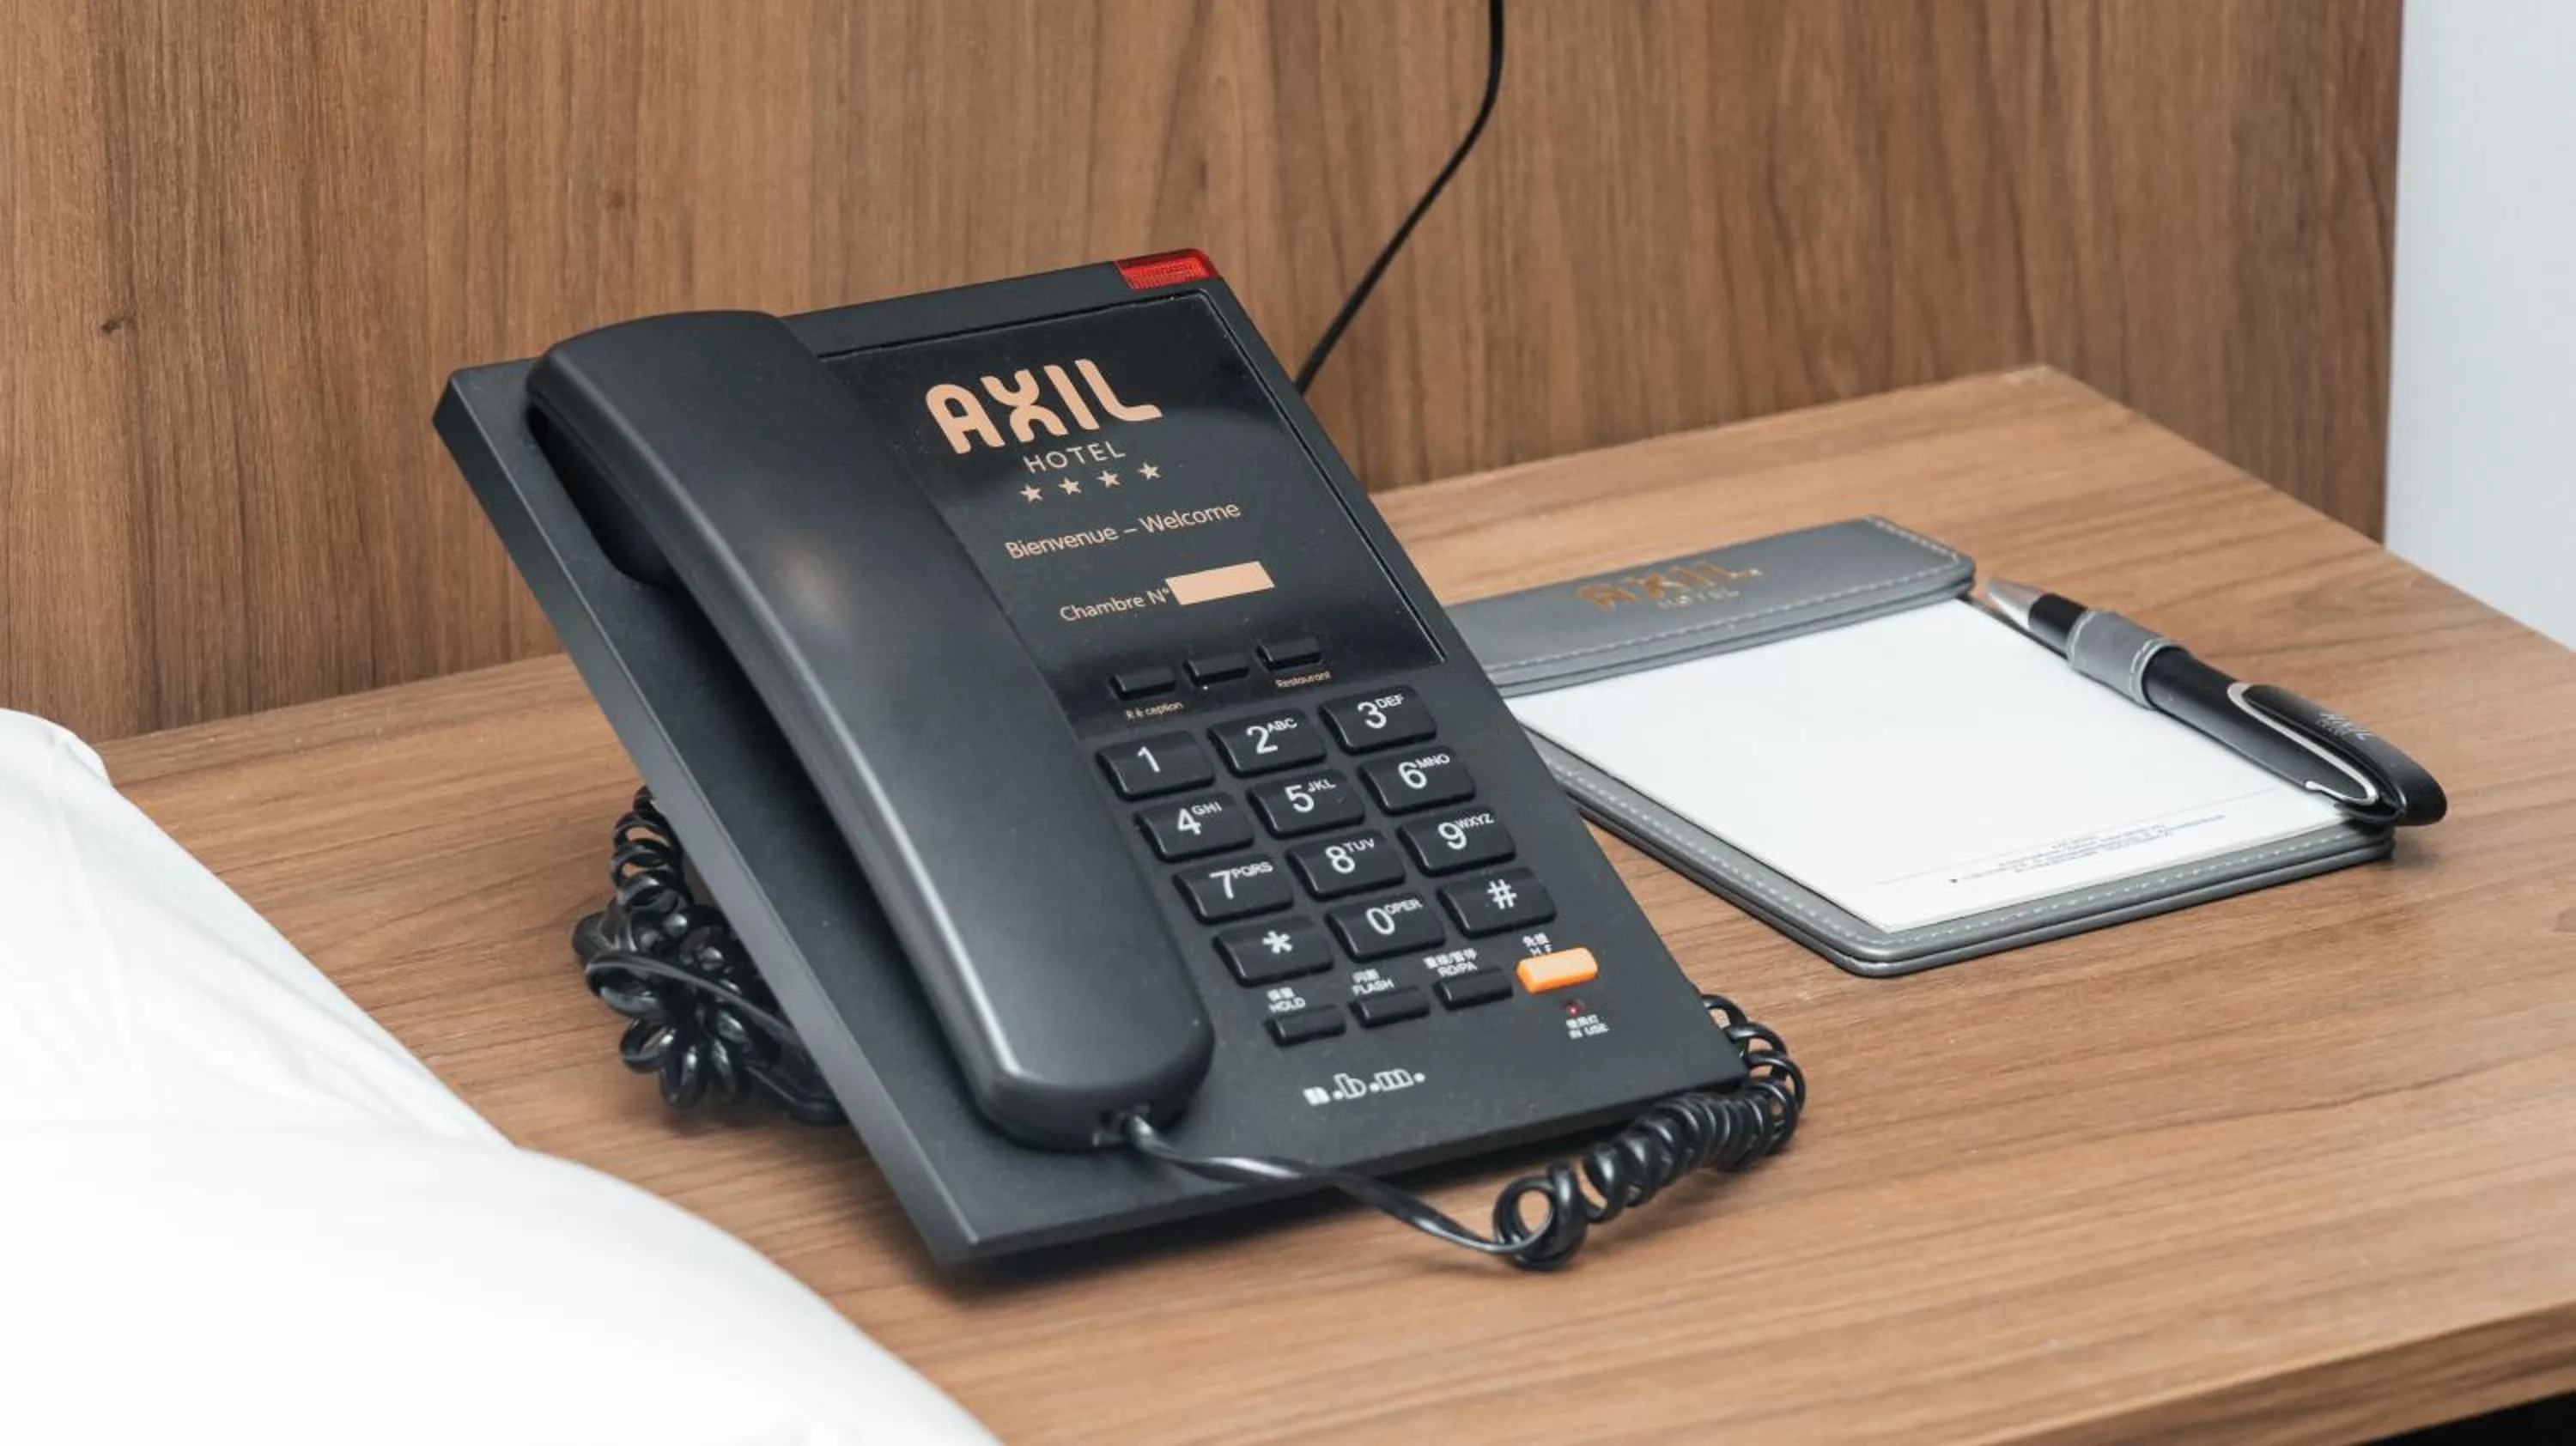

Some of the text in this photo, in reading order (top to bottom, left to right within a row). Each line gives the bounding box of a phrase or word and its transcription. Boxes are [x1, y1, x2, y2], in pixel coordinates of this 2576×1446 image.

[926, 359, 1163, 453] AXIL
[1024, 441, 1125, 473] HOTEL
[1005, 528, 1118, 558] Bienvenue
[1139, 505, 1240, 532] Welcome
[1060, 586, 1170, 621] Chambre N°
[1276, 671, 1331, 687] Restaurant
[1358, 695, 1403, 728] 3 DEF
[1247, 718, 1297, 754] 2 ABC
[1138, 747, 1160, 772] 1
[1399, 754, 1449, 788] 6 MNO
[1285, 780, 1336, 812] 5 JKL
[1178, 802, 1222, 835] 4 GHI
[1438, 814, 1494, 849] 9 WXYZ
[1326, 838, 1374, 873] 8 TUV
[1209, 862, 1273, 899] 7 PQRS
[1487, 879, 1516, 909] #
[1366, 899, 1422, 934] 0 OPER
[1352, 979, 1394, 995] FLASH
[1269, 997, 1305, 1012] HOLD
